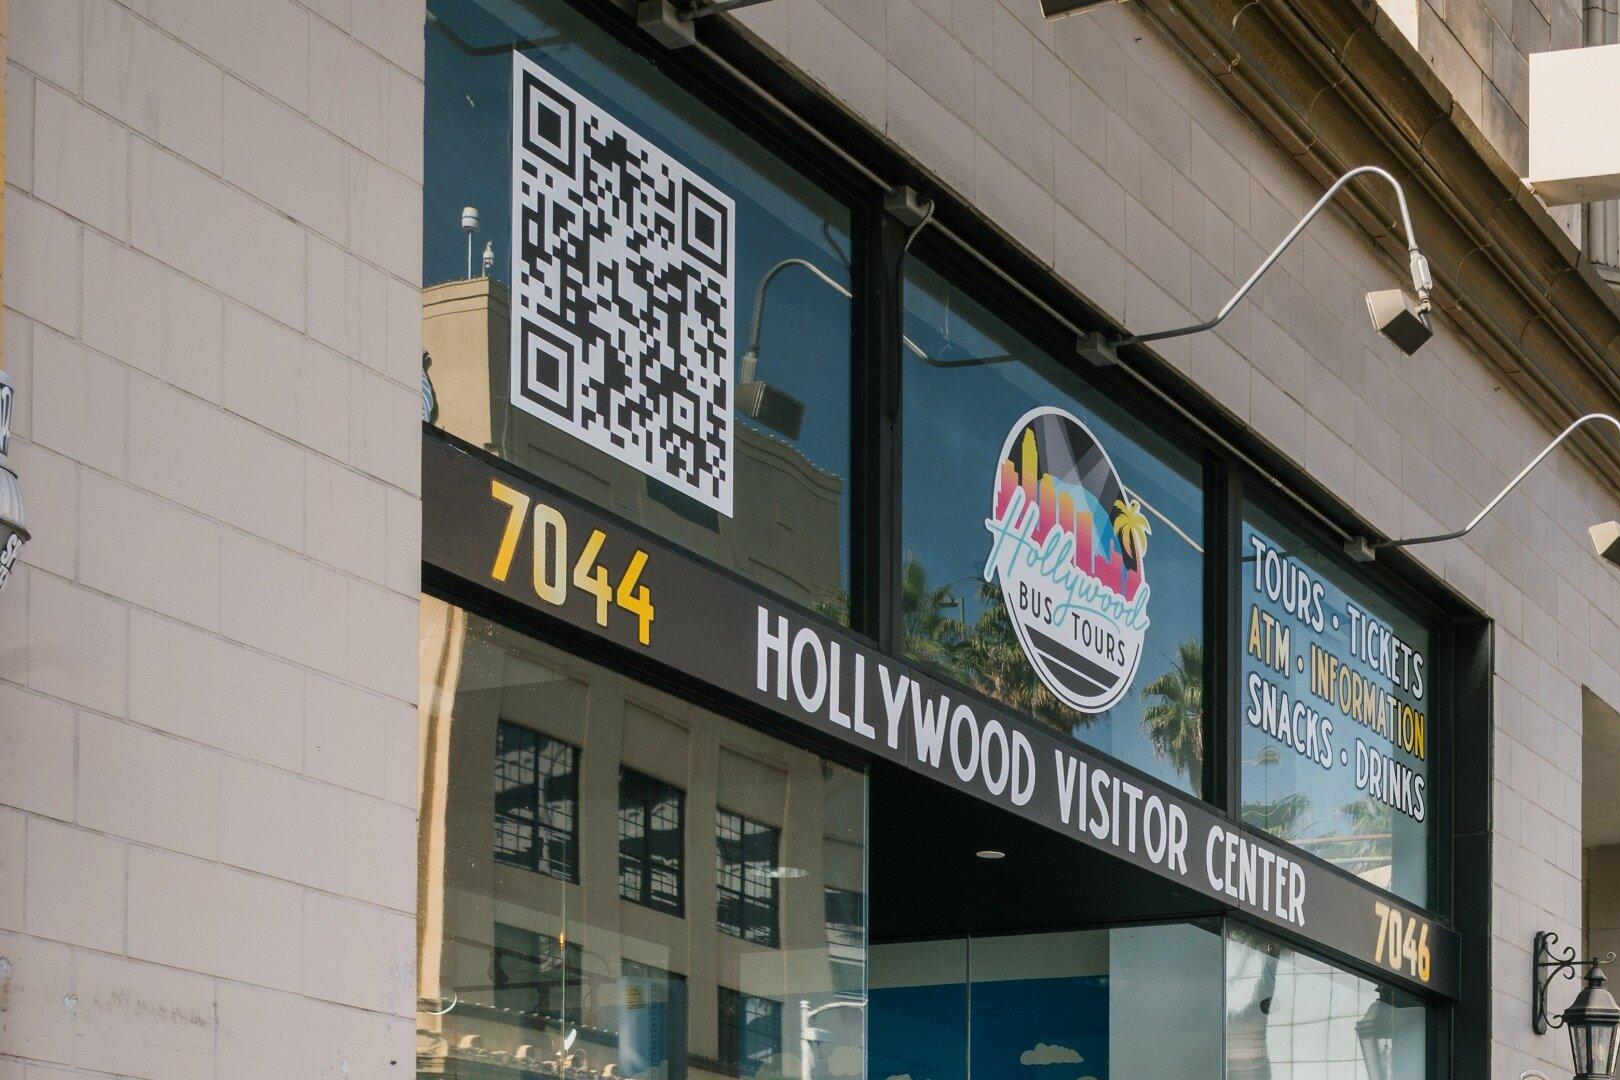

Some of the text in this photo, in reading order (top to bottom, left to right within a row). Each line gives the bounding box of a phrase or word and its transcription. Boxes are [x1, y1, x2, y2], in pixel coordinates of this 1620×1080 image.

[490, 478, 655, 646] 7044
[984, 492, 1149, 630] Hollywood
[1018, 579, 1127, 668] BUS TOURS
[1249, 534, 1425, 699] TOURS TICKETS
[1246, 673, 1426, 822] SNACKS DRINKS
[1247, 604, 1425, 762] ATM INFORMATION
[756, 605, 1307, 927] HOLLYWOOD VISITOR CENTER
[1374, 902, 1432, 983] 7046
